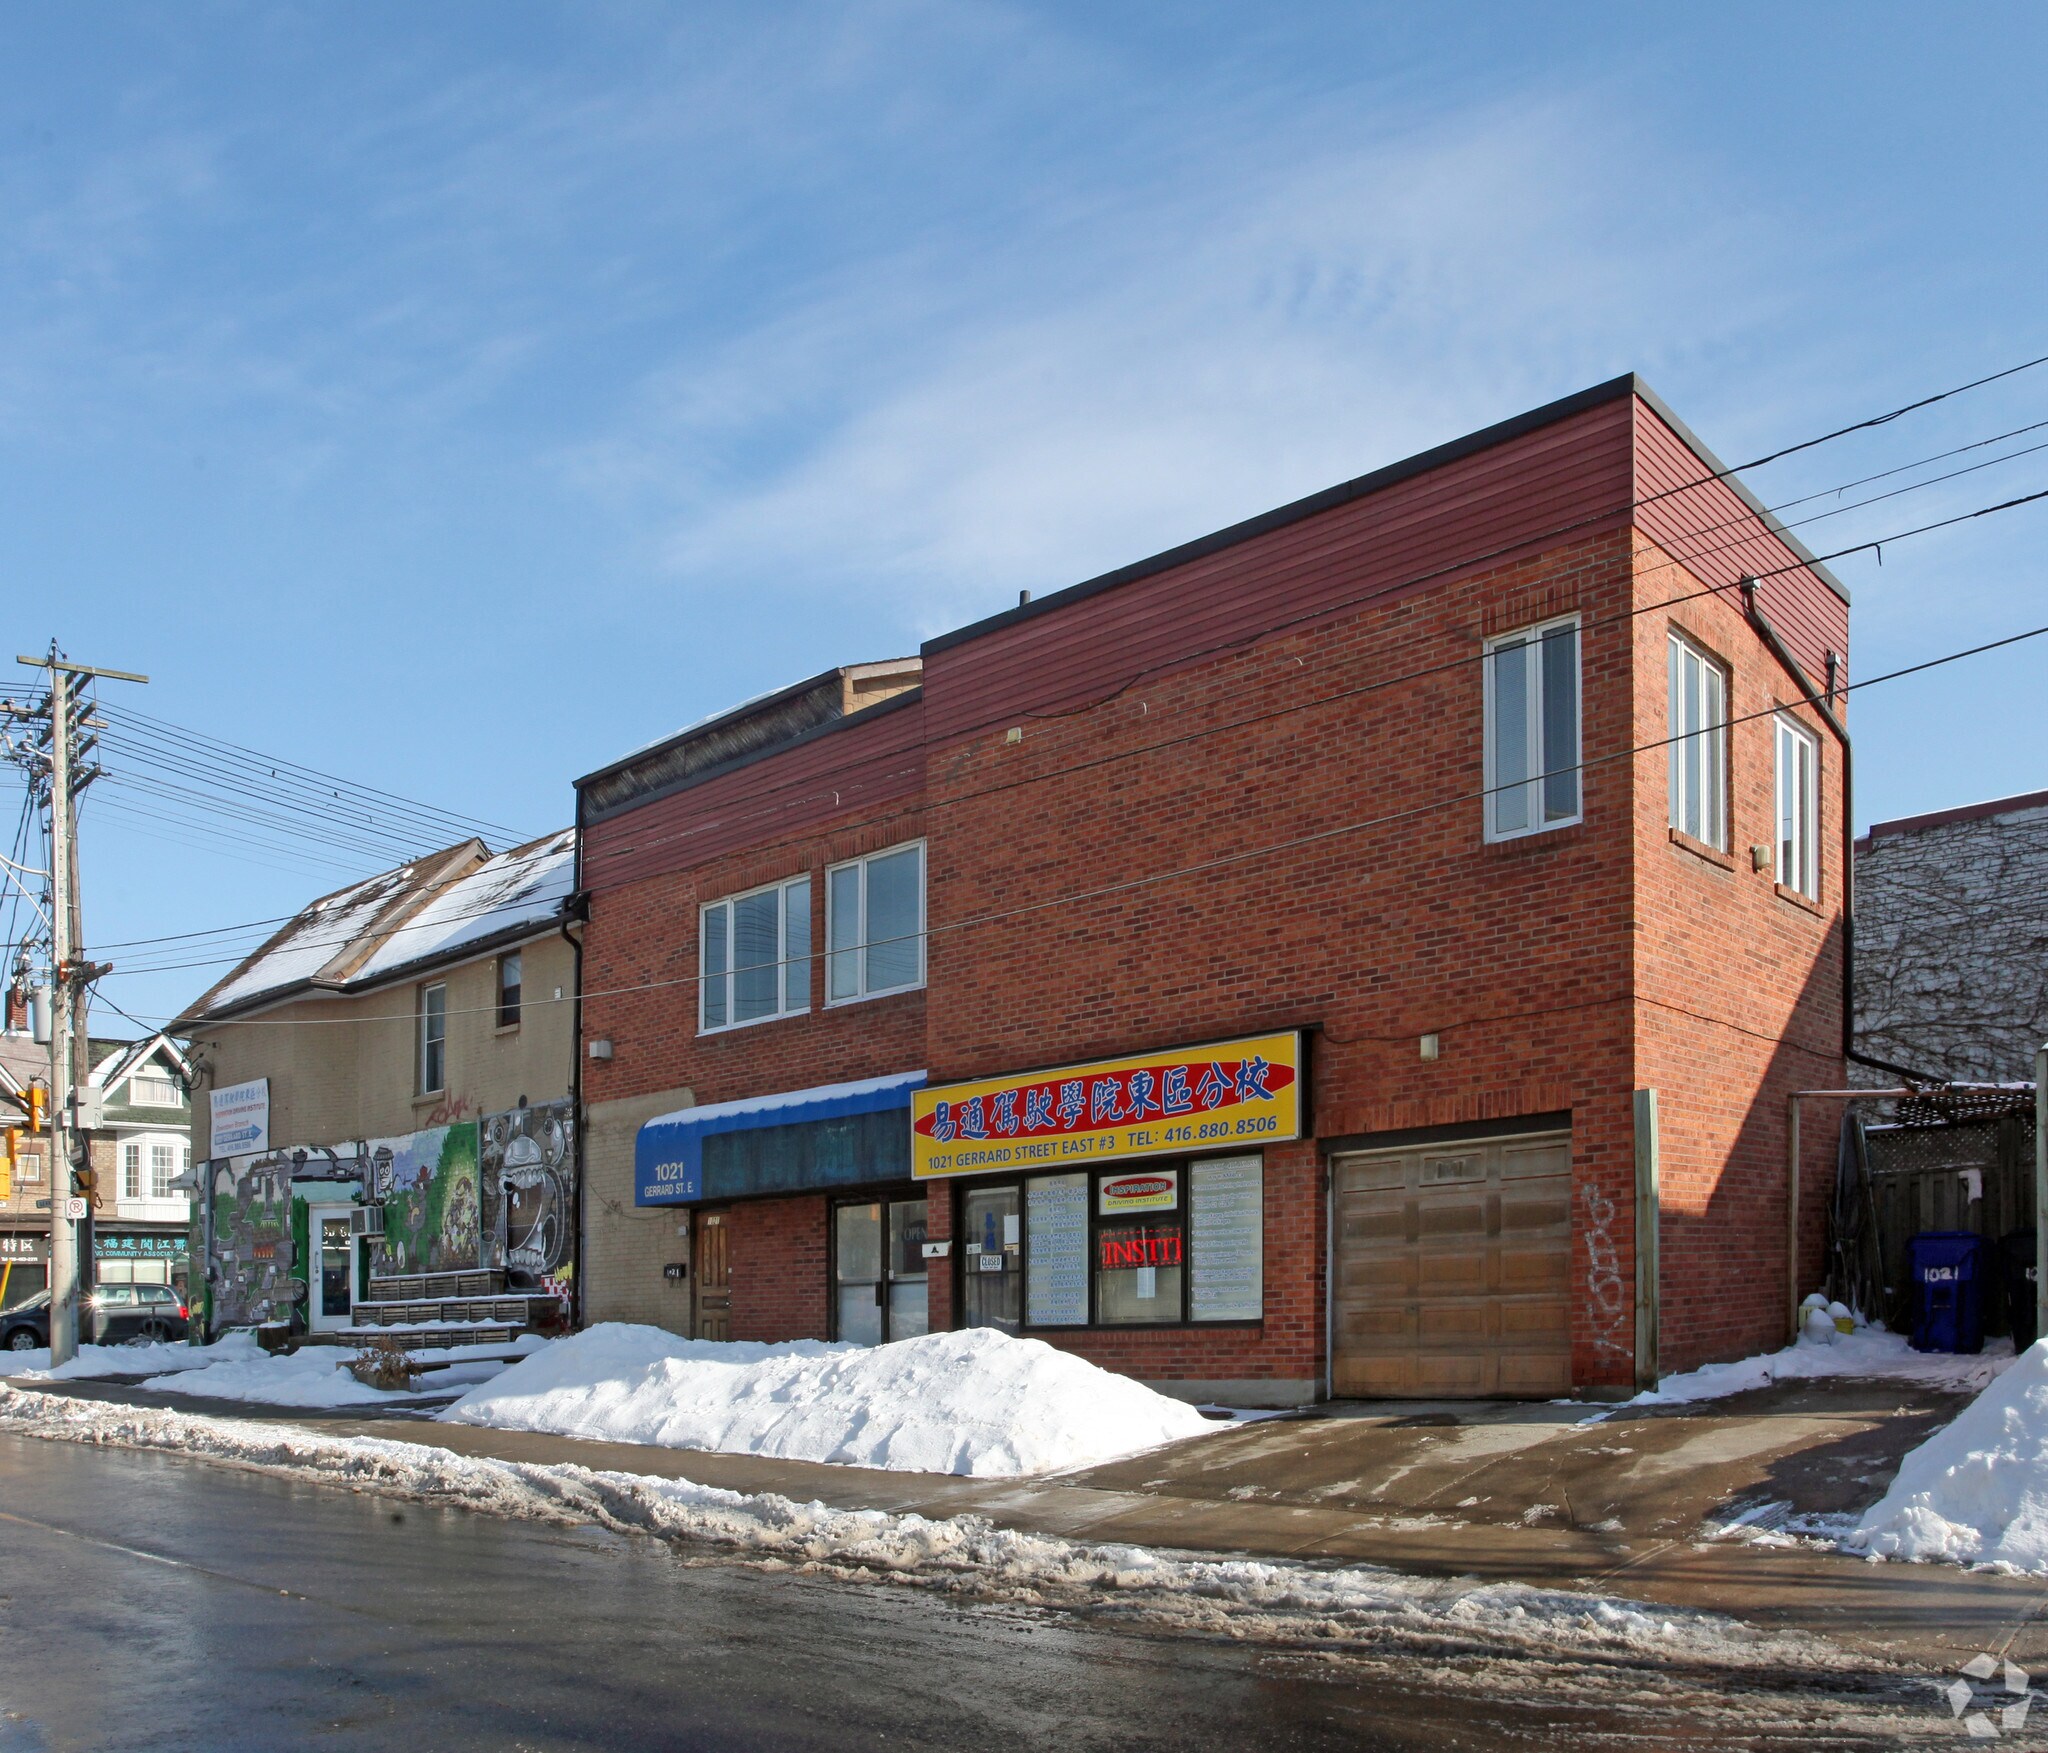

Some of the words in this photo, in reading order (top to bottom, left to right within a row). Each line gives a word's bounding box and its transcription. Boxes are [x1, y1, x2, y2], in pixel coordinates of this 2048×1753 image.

[931, 1055, 1275, 1143] 易通駕駛學院東區分校
[928, 1155, 952, 1169] 1021
[956, 1148, 1011, 1166] GERRARD
[1015, 1142, 1058, 1159] STREET
[1062, 1137, 1095, 1154] EAST
[1099, 1135, 1115, 1150] #3
[1128, 1130, 1159, 1147] TEL:
[1165, 1115, 1277, 1142] 416.880.8506
[655, 1162, 684, 1181] 1021
[644, 1184, 674, 1197] GERRARD
[675, 1183, 686, 1194] ST.
[687, 1181, 694, 1193] E.
[1109, 1181, 1167, 1195] INSPIRATION
[903, 1226, 928, 1240] OPEN
[981, 1256, 1000, 1266] CLOSED
[1924, 1266, 1958, 1283] 1021
